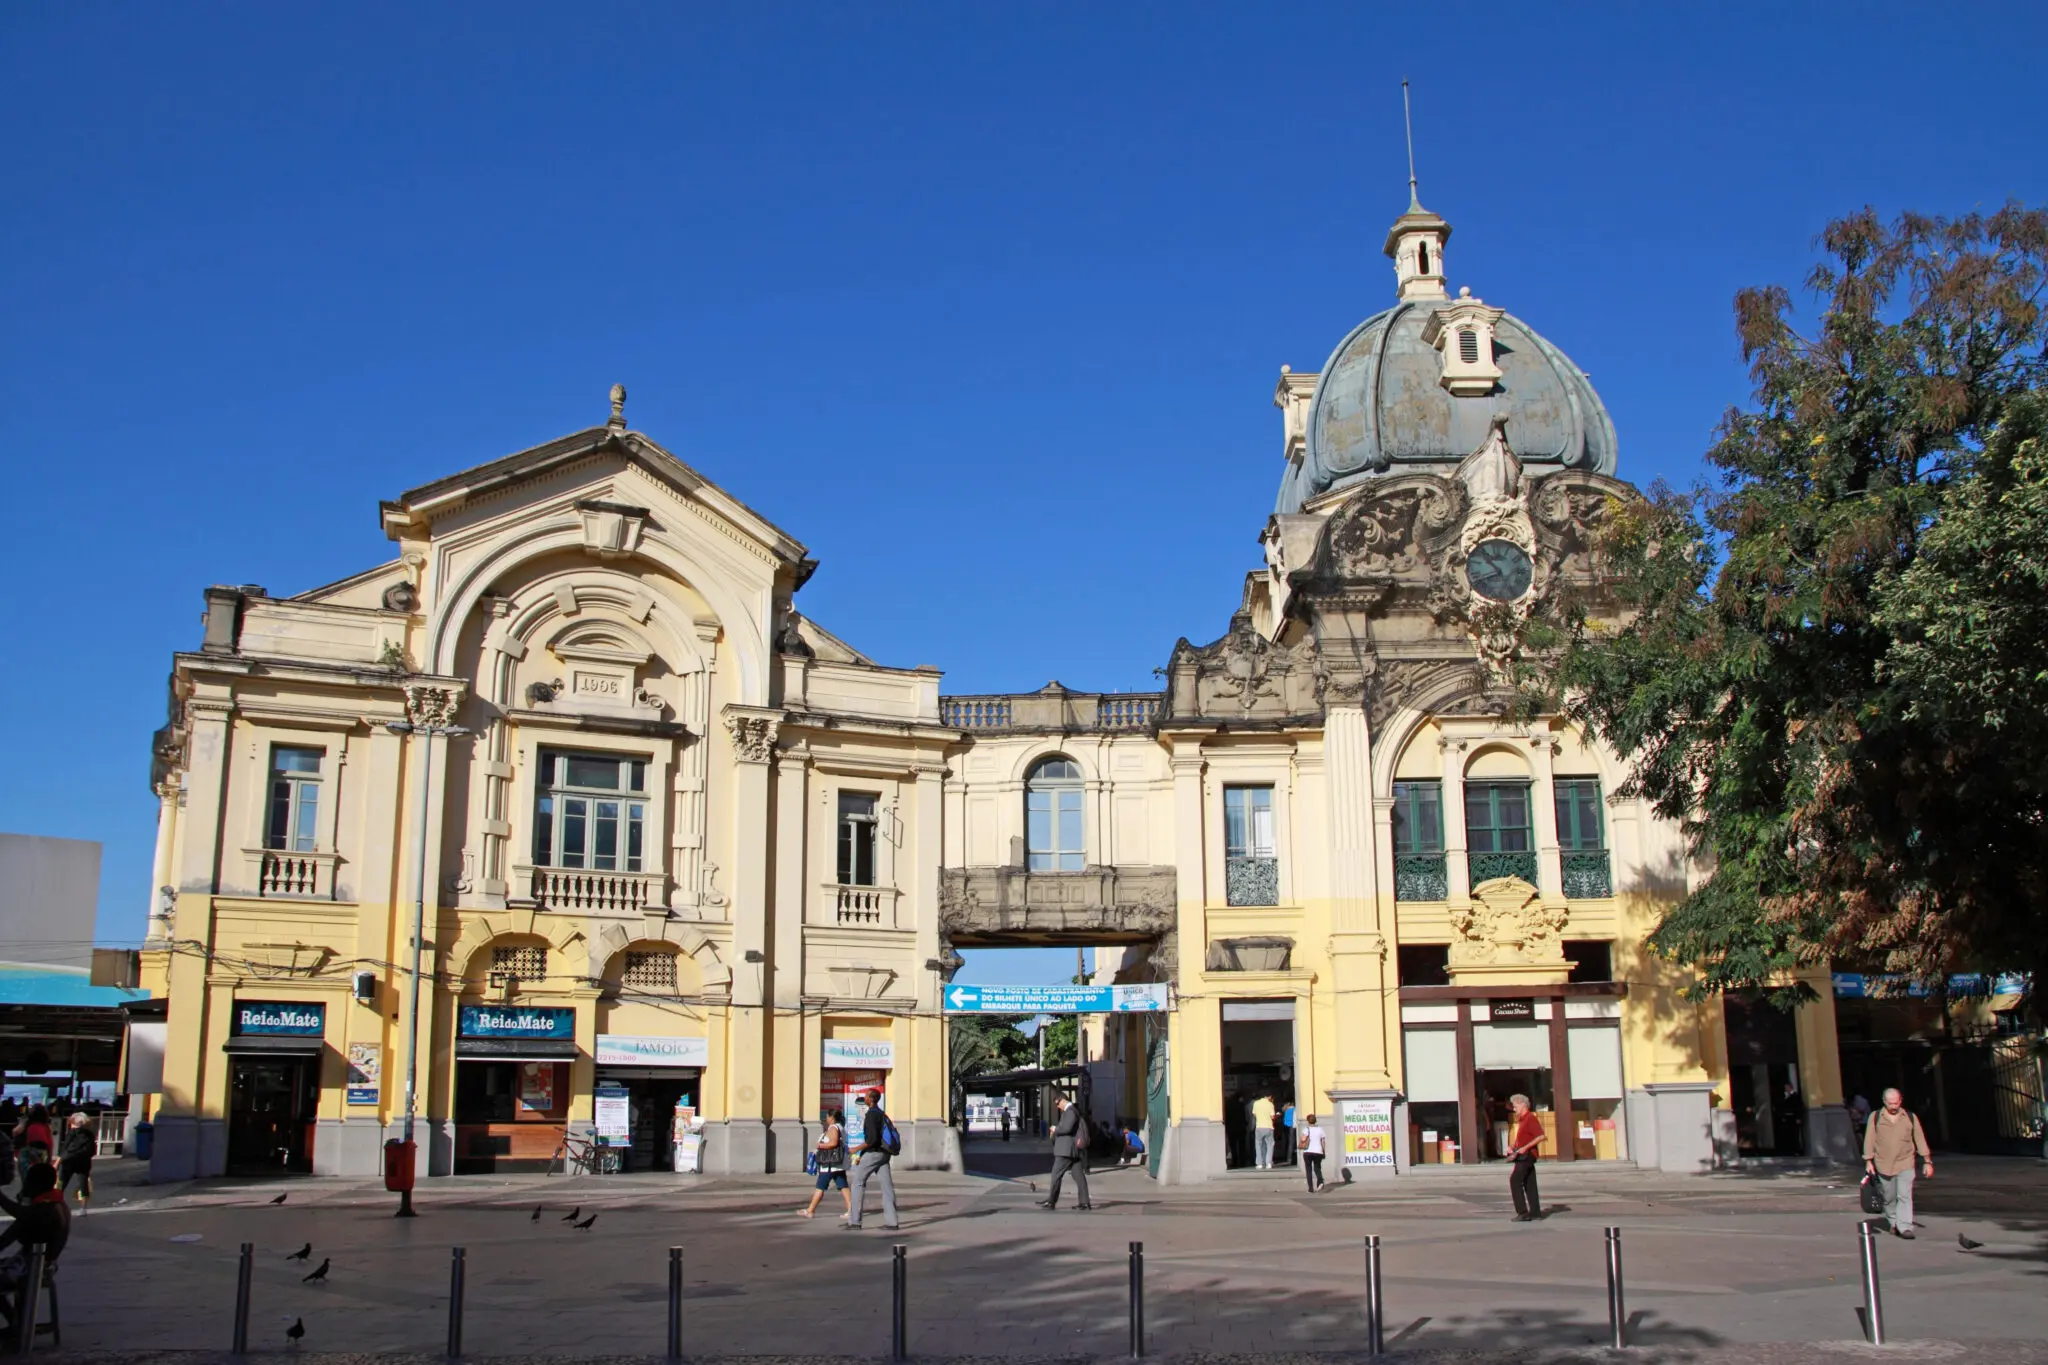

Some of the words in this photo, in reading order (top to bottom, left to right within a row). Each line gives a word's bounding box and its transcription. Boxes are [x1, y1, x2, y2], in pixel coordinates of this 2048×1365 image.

[1043, 1001, 1077, 1009] PAQUETÁ
[635, 1041, 690, 1055] TAMOIO
[840, 1045, 890, 1057] TAMOIO
[1345, 1114, 1367, 1122] MEGA
[1368, 1114, 1389, 1122] SENA
[1344, 1124, 1391, 1133] ACUMULADA
[1357, 1136, 1380, 1149] 23
[1345, 1153, 1392, 1164] MILHÕES
